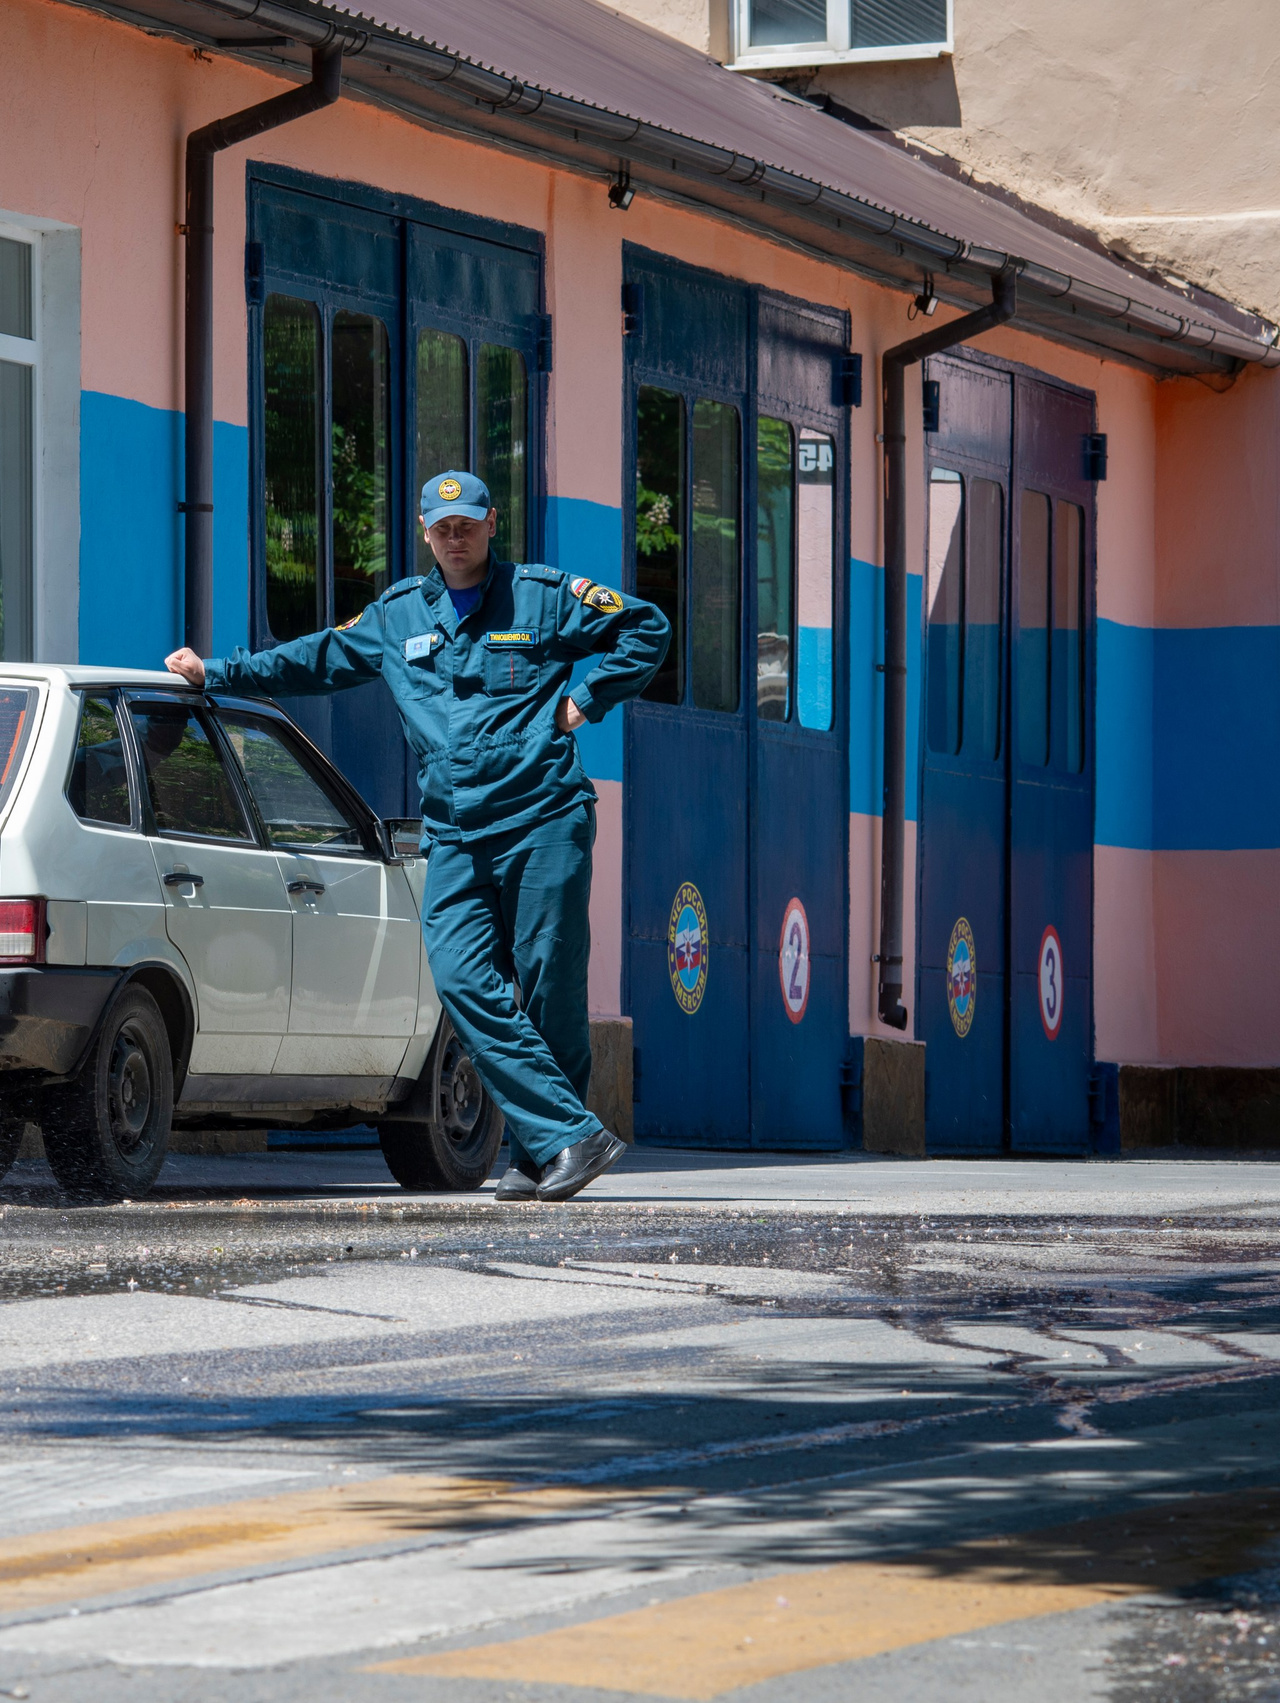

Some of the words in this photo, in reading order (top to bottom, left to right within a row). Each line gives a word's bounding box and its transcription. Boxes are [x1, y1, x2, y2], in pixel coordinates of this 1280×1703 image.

[669, 897, 682, 944] МЧС
[682, 888, 707, 944] РОССИИ
[672, 969, 705, 1010] EMERCOM
[789, 922, 803, 999] 2
[1045, 947, 1057, 1019] 3
